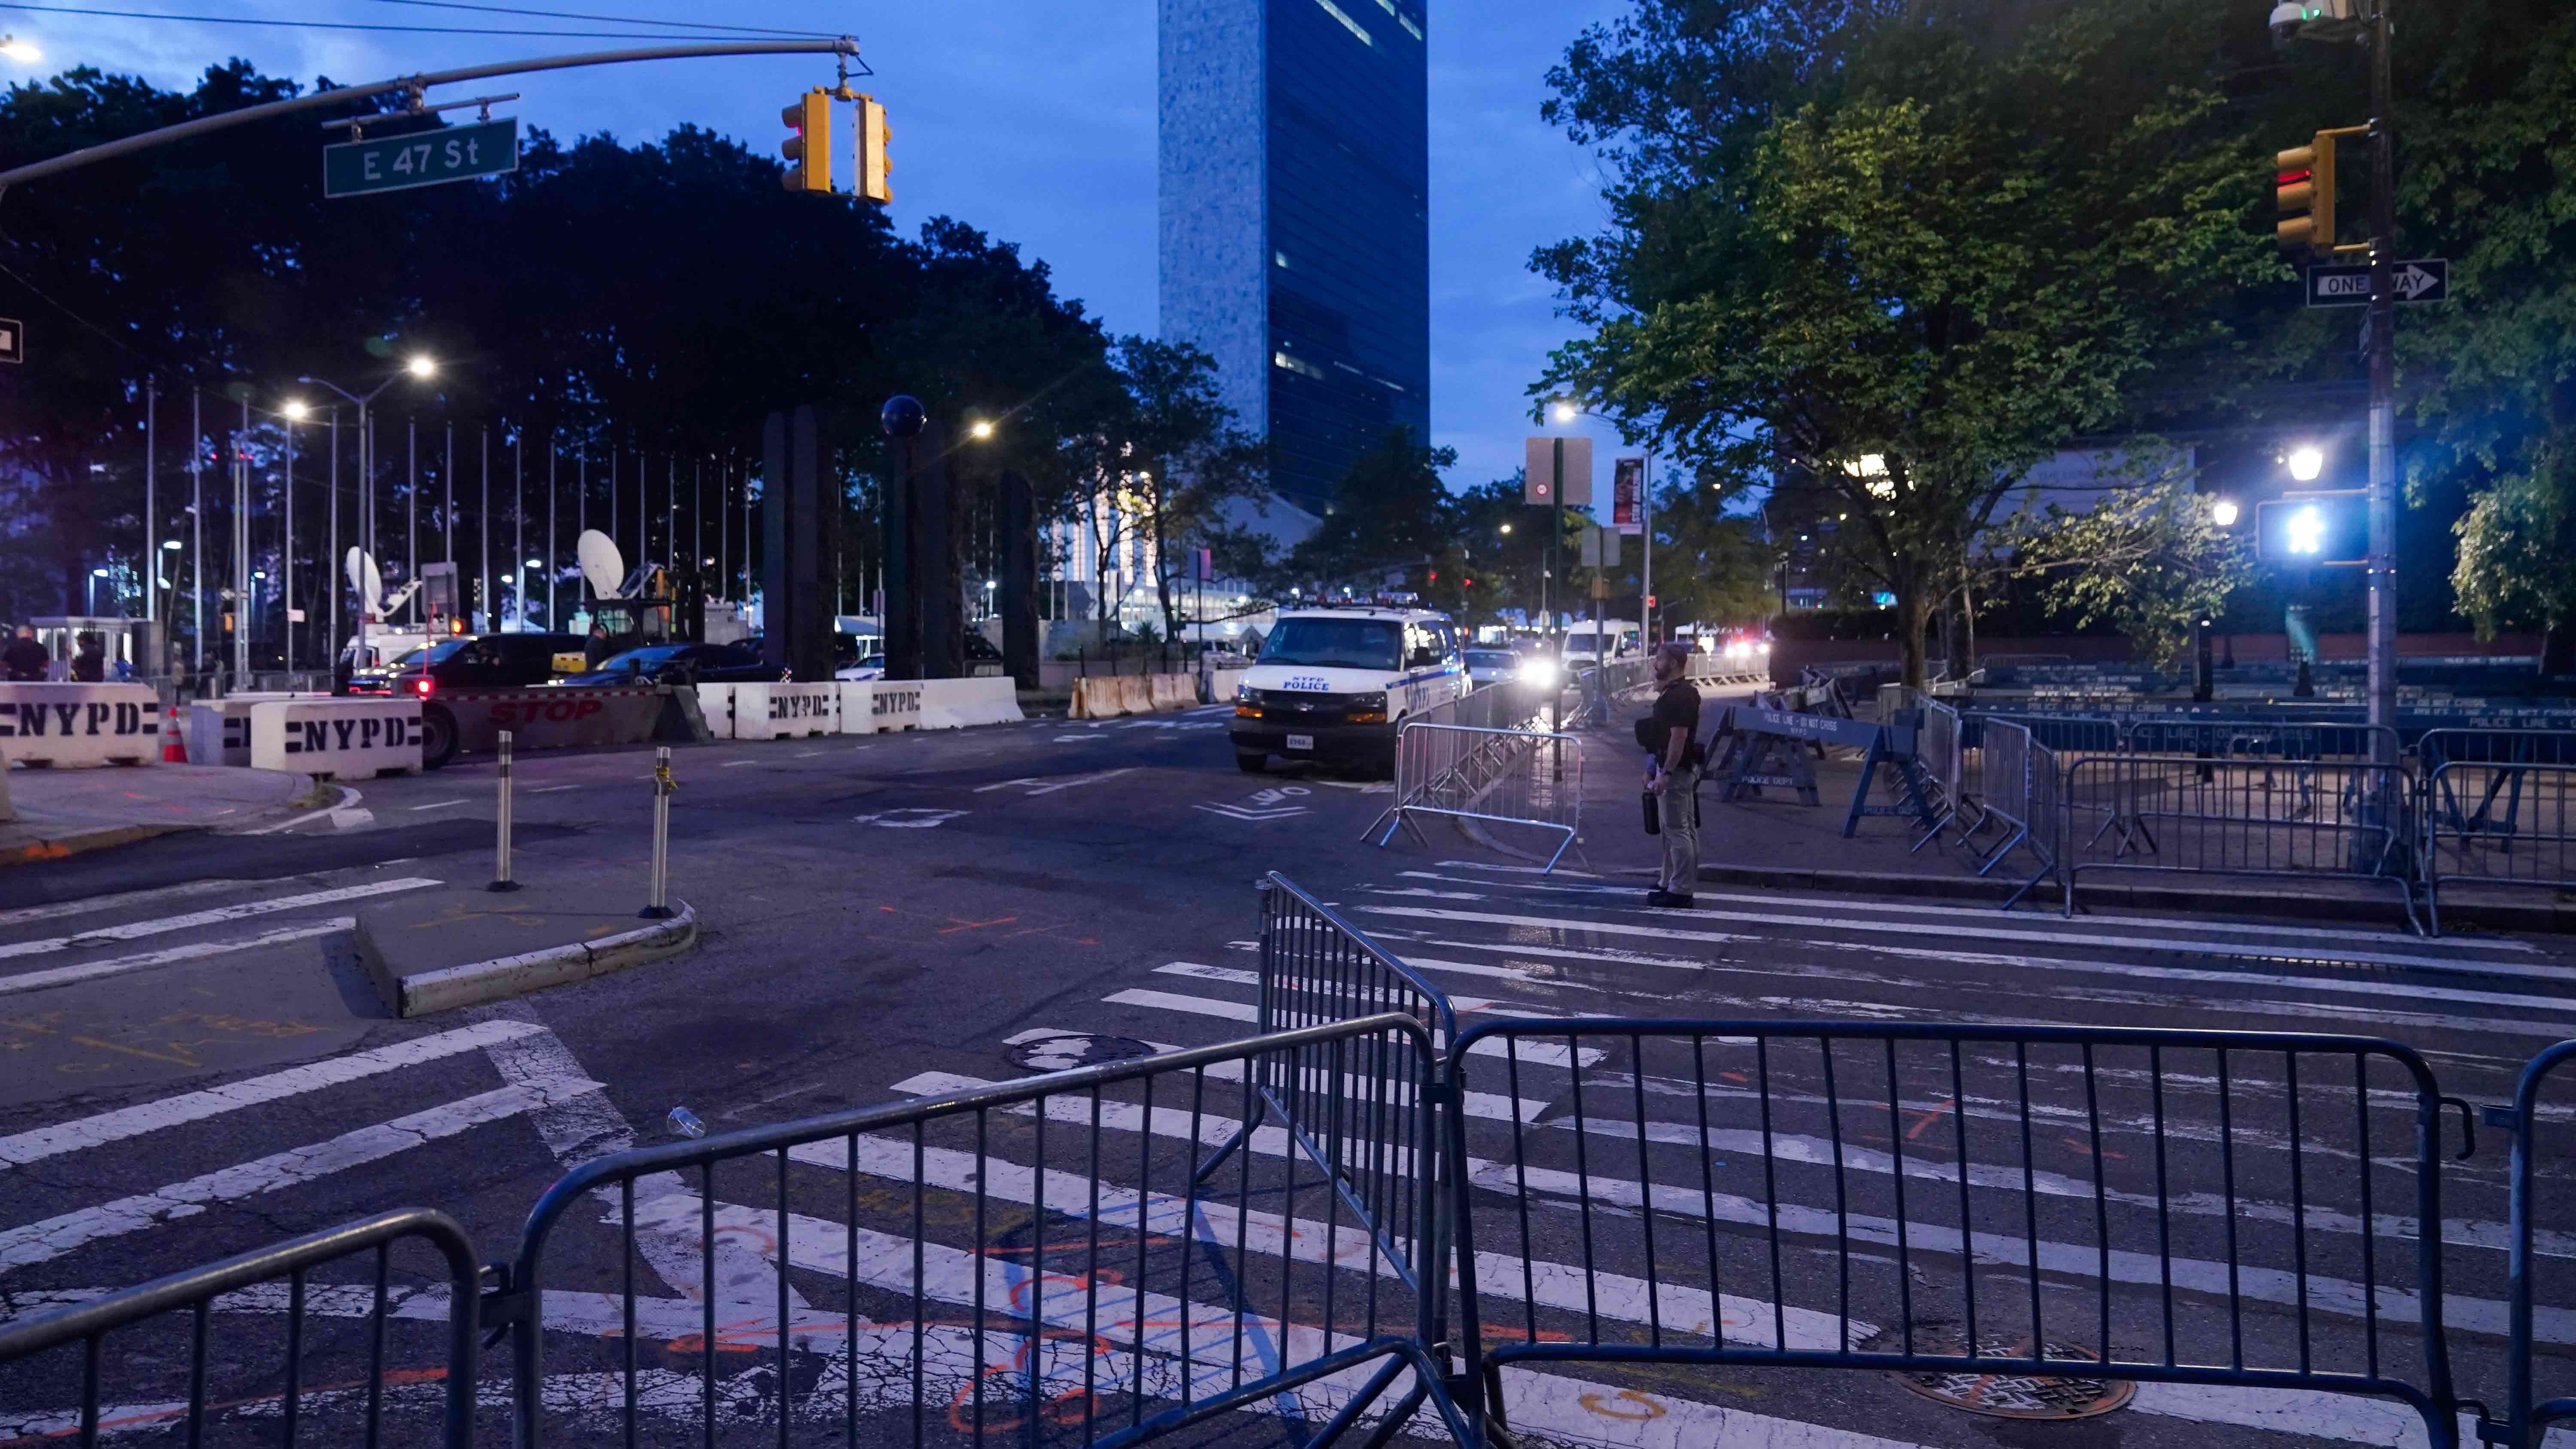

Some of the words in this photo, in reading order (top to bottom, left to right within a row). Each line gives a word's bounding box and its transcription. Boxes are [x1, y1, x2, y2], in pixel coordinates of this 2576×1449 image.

[364, 151, 381, 181] E
[392, 144, 432, 175] 47
[444, 137, 480, 169] St
[2329, 278, 2365, 293] ONE
[1283, 681, 1329, 691] POLICE
[489, 700, 603, 723] STOP
[778, 695, 822, 719] NYPD
[879, 692, 915, 715] NYPD
[19, 702, 139, 735] NYPD
[2470, 717, 2511, 727] POLICE
[2521, 718, 2549, 729] LINE
[305, 717, 404, 751] NYPD
[1741, 776, 1769, 784] POLICE
[1772, 777, 1793, 785] DEPT
